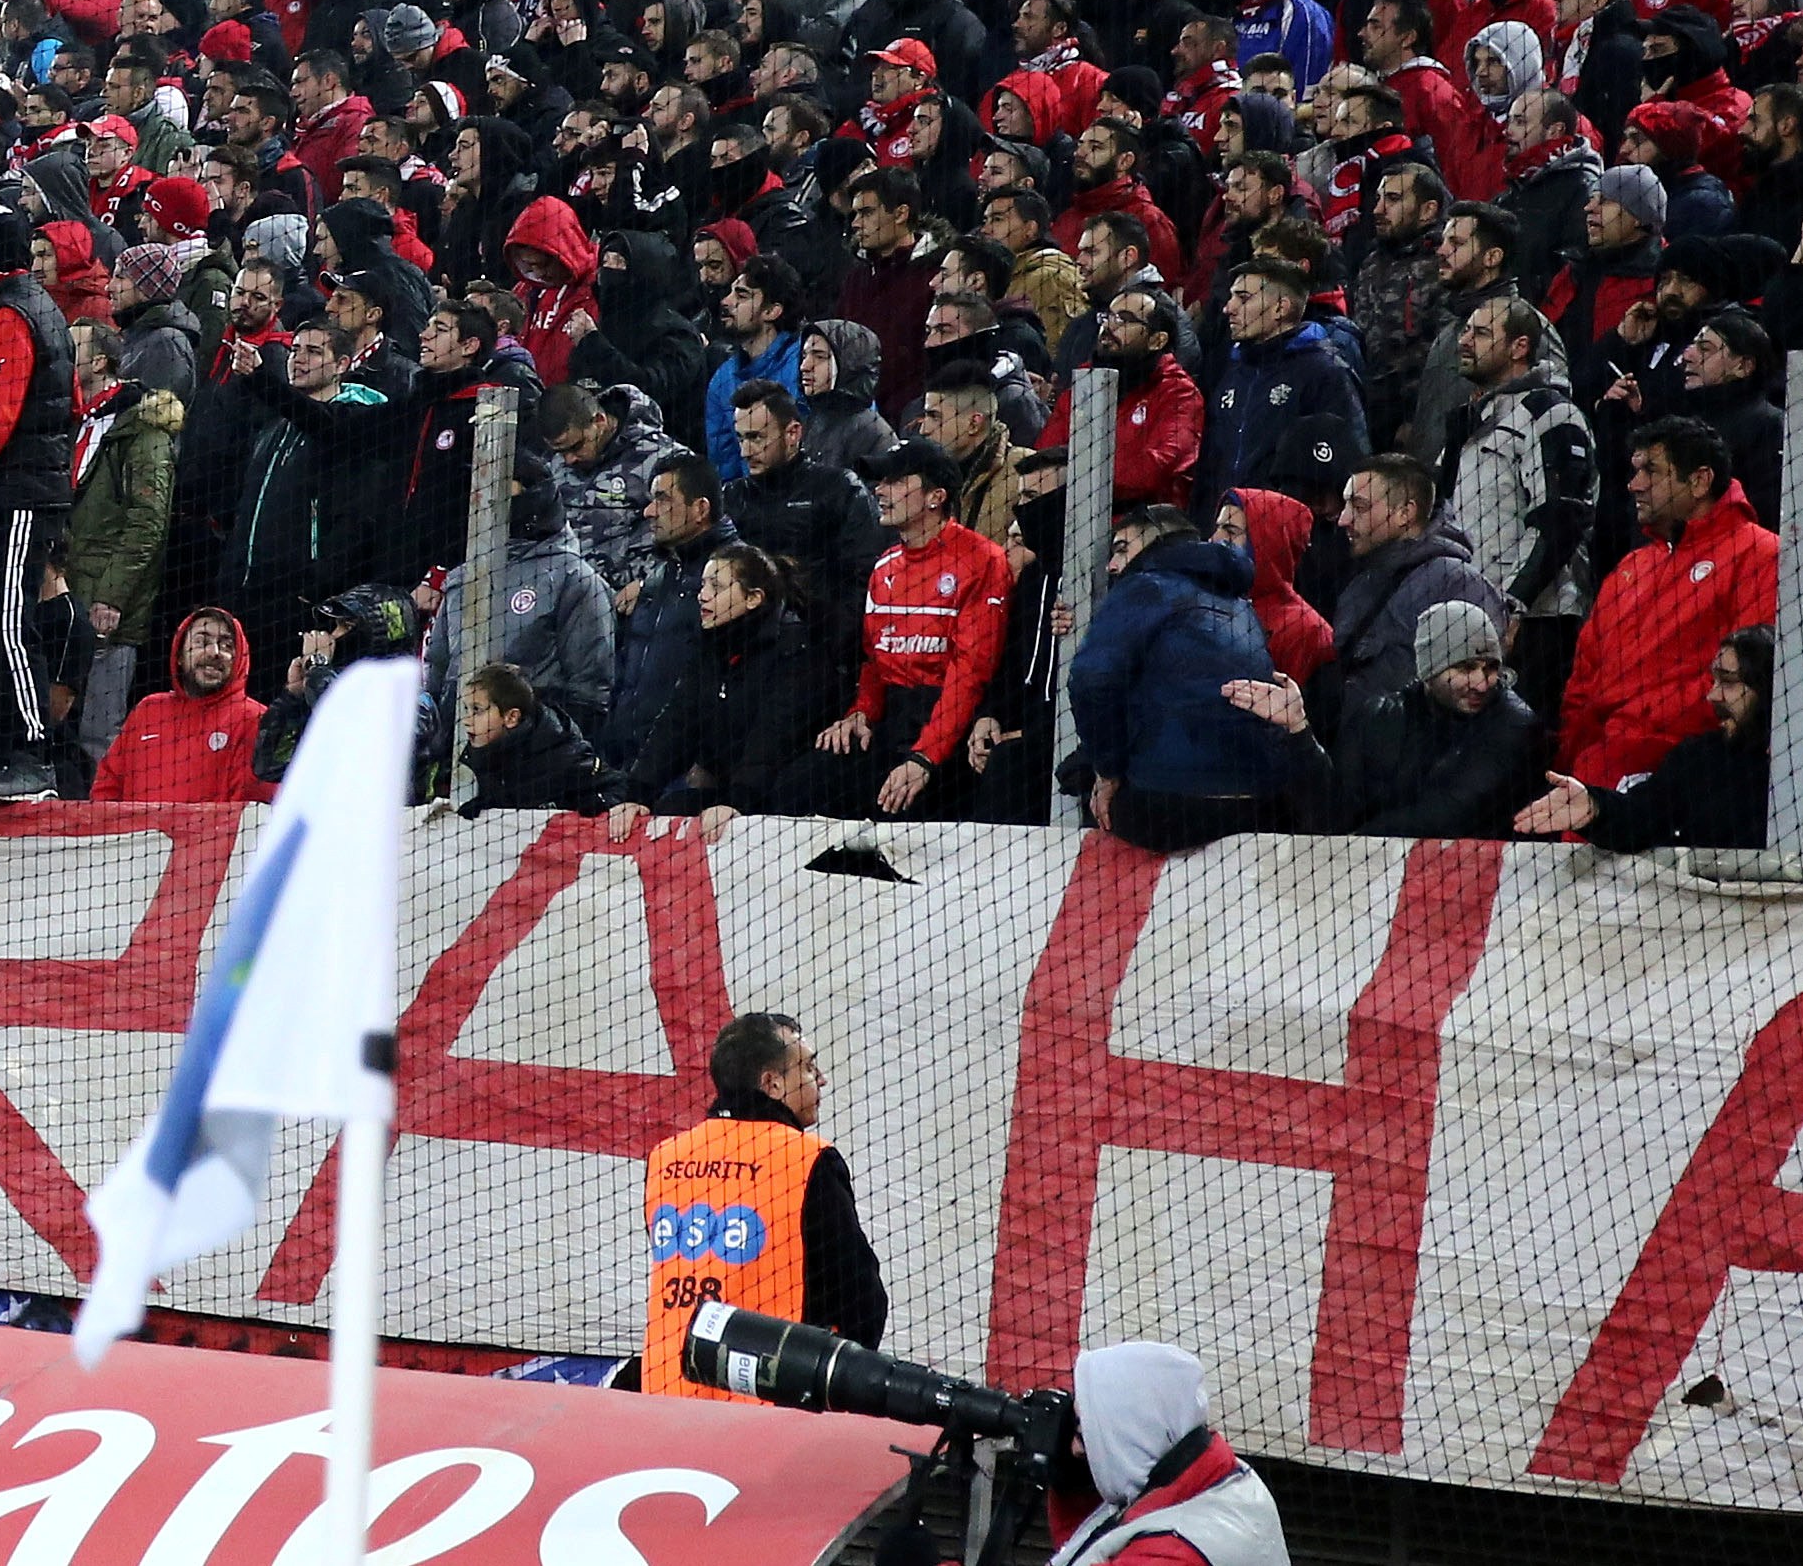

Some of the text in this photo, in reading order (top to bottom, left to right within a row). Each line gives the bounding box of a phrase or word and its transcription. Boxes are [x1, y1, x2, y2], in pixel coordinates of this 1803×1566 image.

[663, 1160, 763, 1181] SECURITY
[654, 1216, 748, 1250] esa
[662, 1276, 723, 1310] 388
